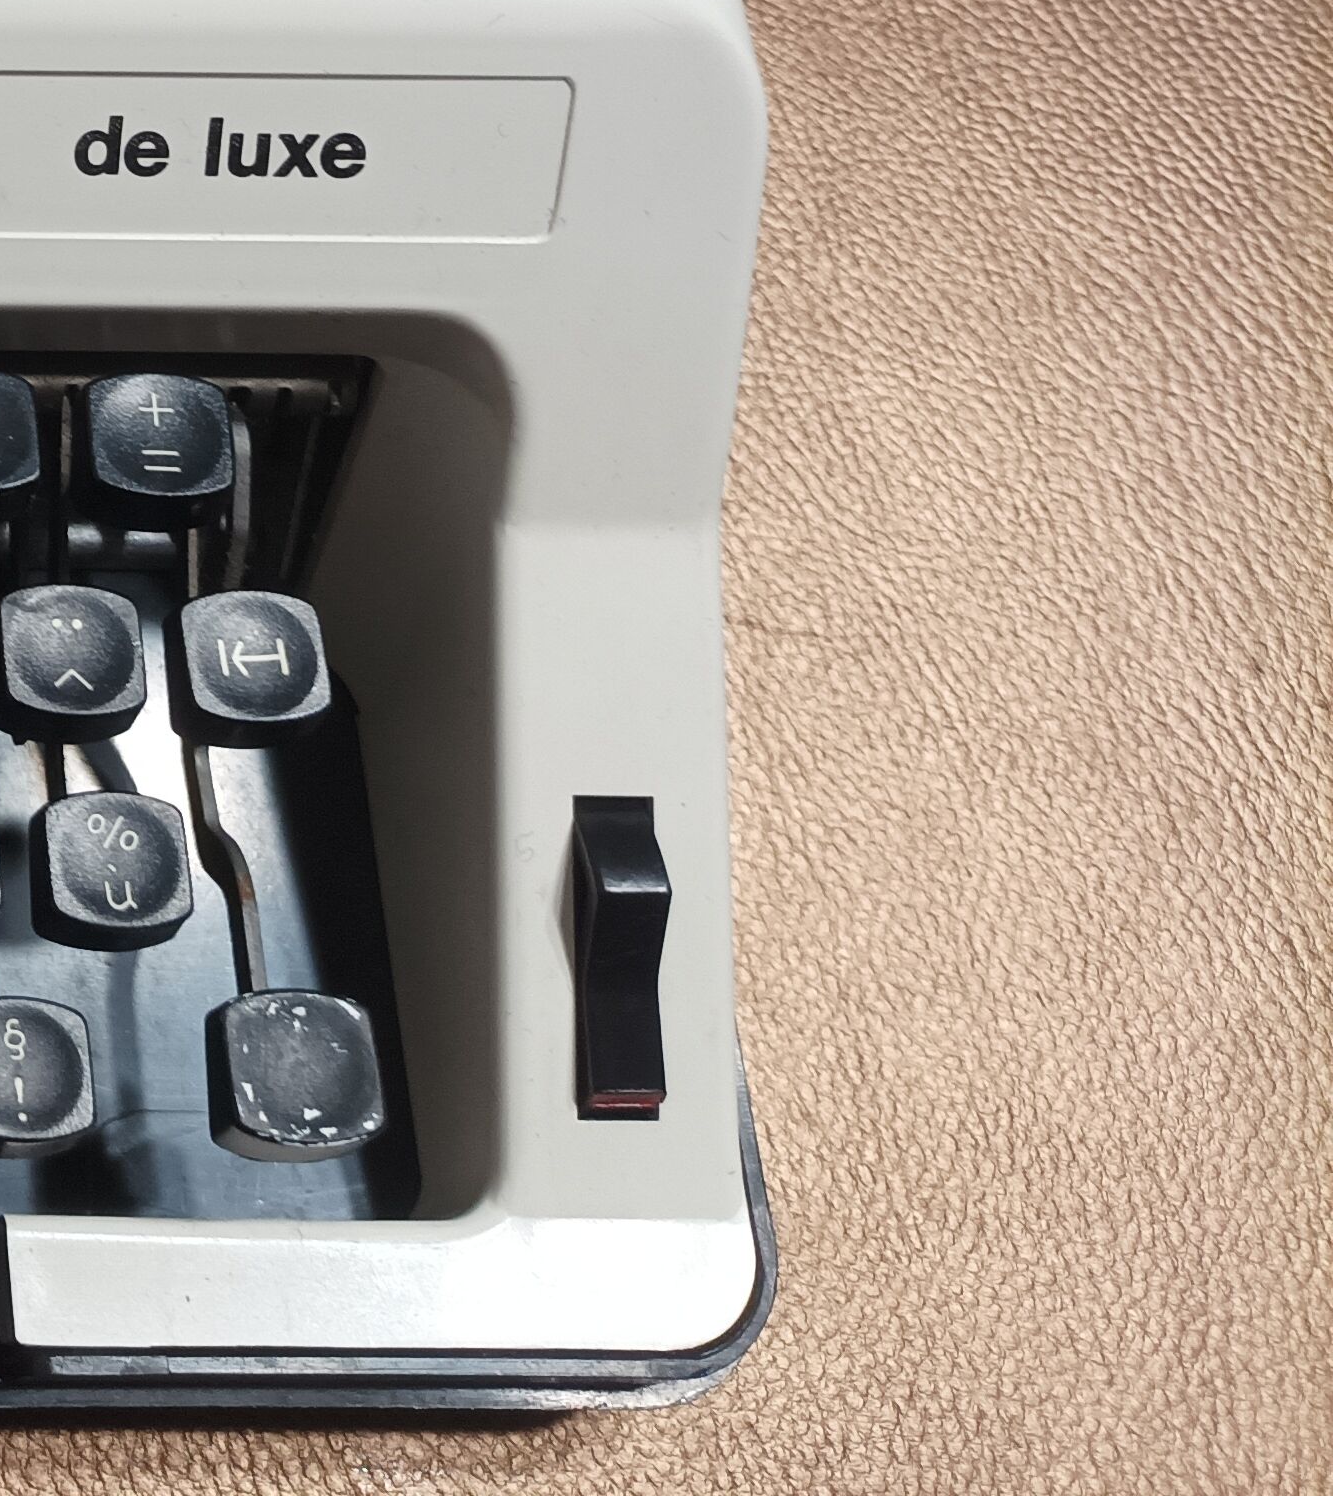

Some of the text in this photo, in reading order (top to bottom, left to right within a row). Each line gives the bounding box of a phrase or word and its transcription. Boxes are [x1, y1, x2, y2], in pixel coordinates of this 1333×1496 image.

[74, 115, 367, 179] de luxe
[137, 392, 175, 427] +
[140, 449, 183, 473] =
[86, 812, 141, 853] %
[102, 864, 139, 911] ù
[2, 1017, 28, 1061] §
[13, 1076, 29, 1122] !
